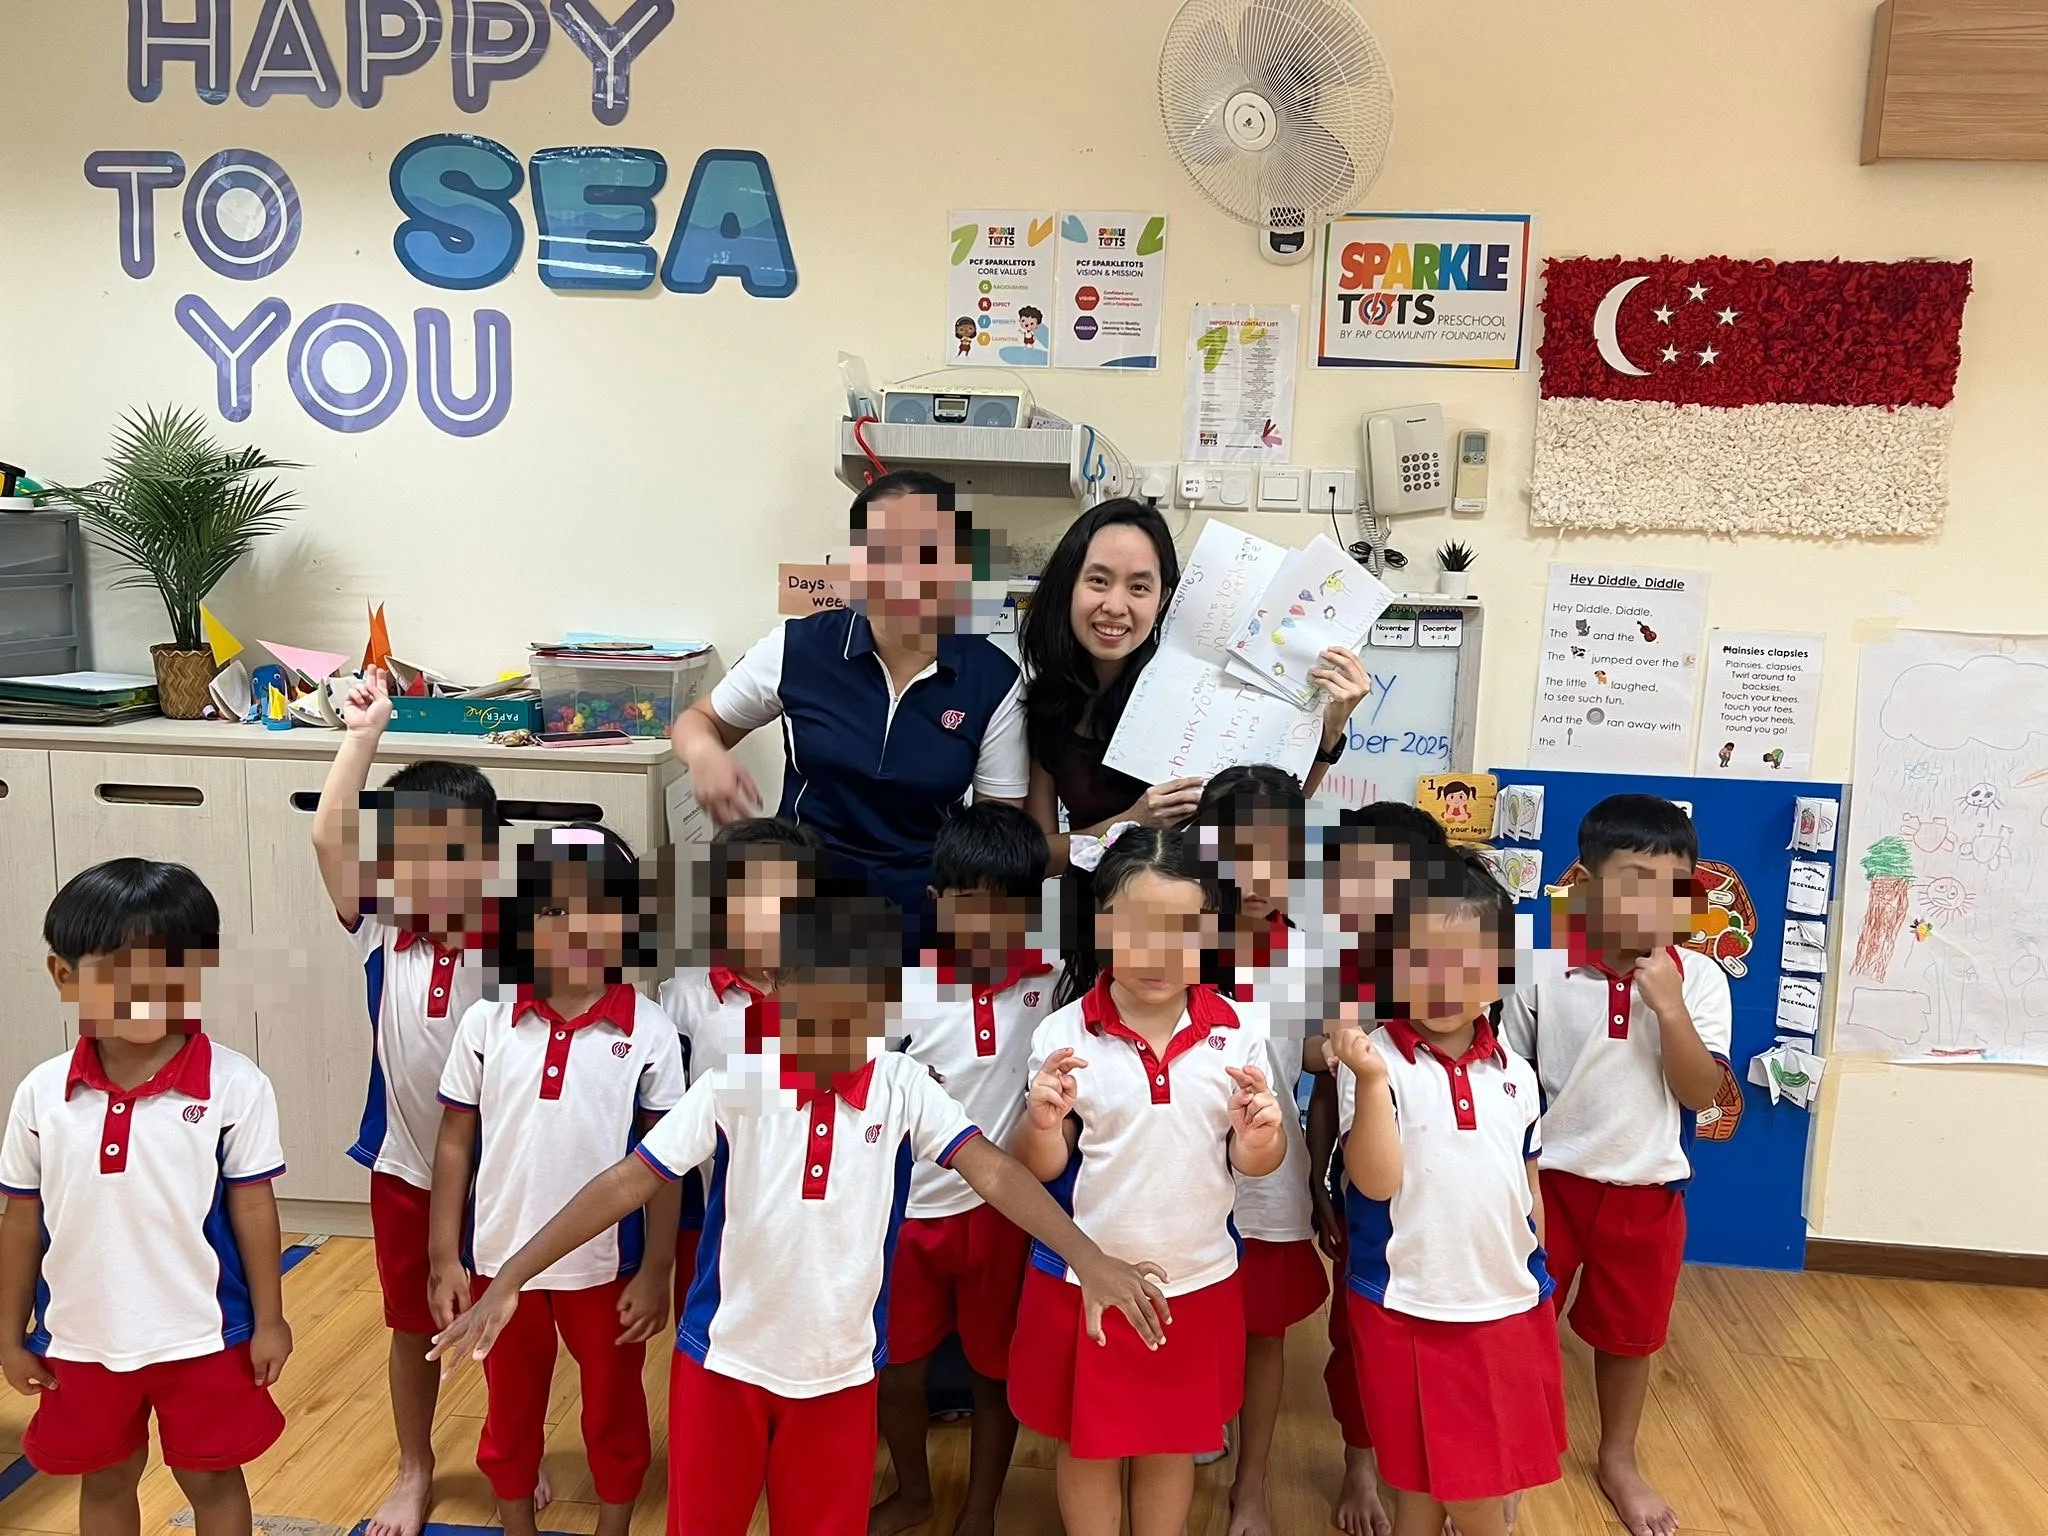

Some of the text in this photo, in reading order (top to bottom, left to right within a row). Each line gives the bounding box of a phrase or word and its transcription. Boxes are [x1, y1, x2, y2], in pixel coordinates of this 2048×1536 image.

[127, 0, 675, 125] HAPPY
[84, 133, 798, 298] TO SEA
[1092, 260, 1144, 268] SPARKLETOTS
[1338, 242, 1510, 291] SPARKLE
[1000, 268, 1028, 276] VALUES
[1338, 293, 1506, 327] TOTS PRESCHOOL
[1340, 330, 1506, 341] BY PAP COMMUNITY FOUNDATION
[174, 294, 512, 437] YOU
[788, 575, 825, 594] Days
[1570, 573, 1685, 589] Hey Diddle, Diddle
[1552, 603, 1573, 614] Hey
[1550, 629, 1635, 642] The and the
[1722, 645, 1809, 659] Plainsies clapsies
[1548, 652, 1679, 668] The jumped over the
[1545, 677, 1563, 687] The
[1566, 677, 1587, 688] little
[1731, 671, 1796, 682] Twirl around to
[1544, 692, 1554, 701] to
[1557, 694, 1575, 702] see
[1578, 694, 1603, 704] such
[1721, 691, 1749, 700] Touch
[1750, 694, 1770, 703] your
[1724, 702, 1750, 711] touch
[1752, 704, 1771, 713] your
[487, 711, 519, 721] PAPER
[1720, 713, 1747, 722] Touch
[1749, 715, 1769, 725] your
[1541, 715, 1681, 732] And the ran away with
[1725, 724, 1752, 732] round
[1754, 725, 1771, 734] you
[1400, 731, 1449, 760] 2025
[1539, 737, 1556, 747] the
[1428, 778, 1436, 790] 1
[1470, 826, 1486, 834] legs
